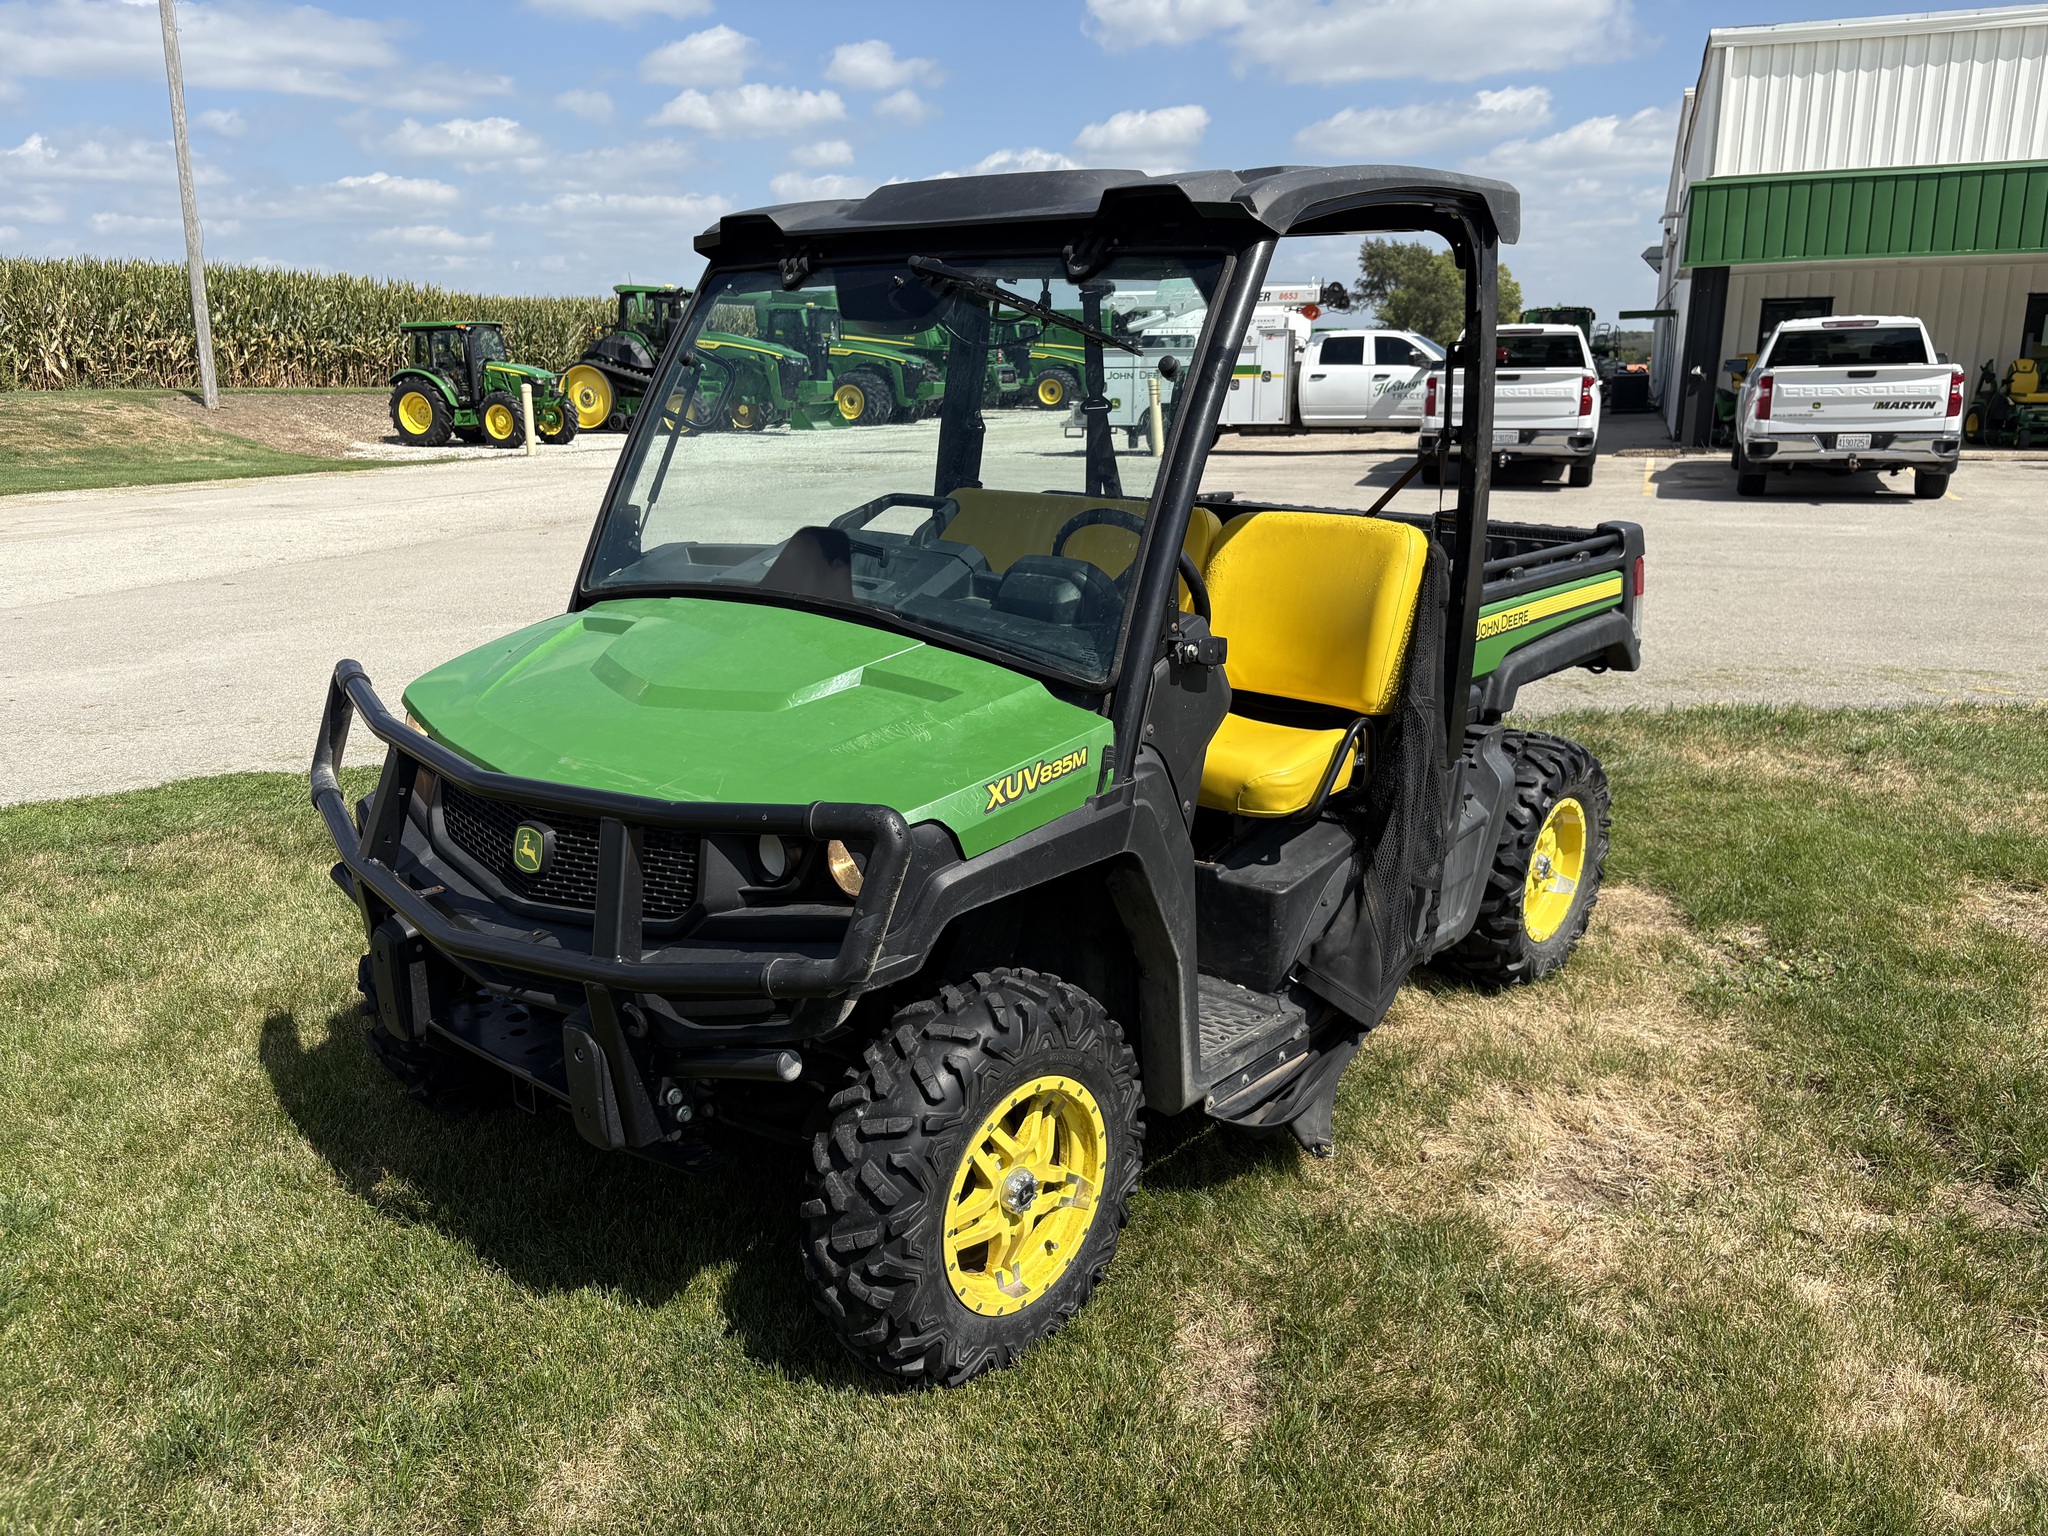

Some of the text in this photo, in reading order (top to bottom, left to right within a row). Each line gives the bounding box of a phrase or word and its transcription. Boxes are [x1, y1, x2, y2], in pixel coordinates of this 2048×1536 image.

[1279, 292, 1298, 301] 8653
[1107, 371, 1134, 380] JOHN
[1373, 380, 1425, 398] Heritage
[1783, 386, 1937, 398] CHEVROLET
[1876, 401, 1937, 410] MARTIN
[1476, 610, 1529, 639] JOHN DEERE
[983, 746, 1088, 816] XUV835M
